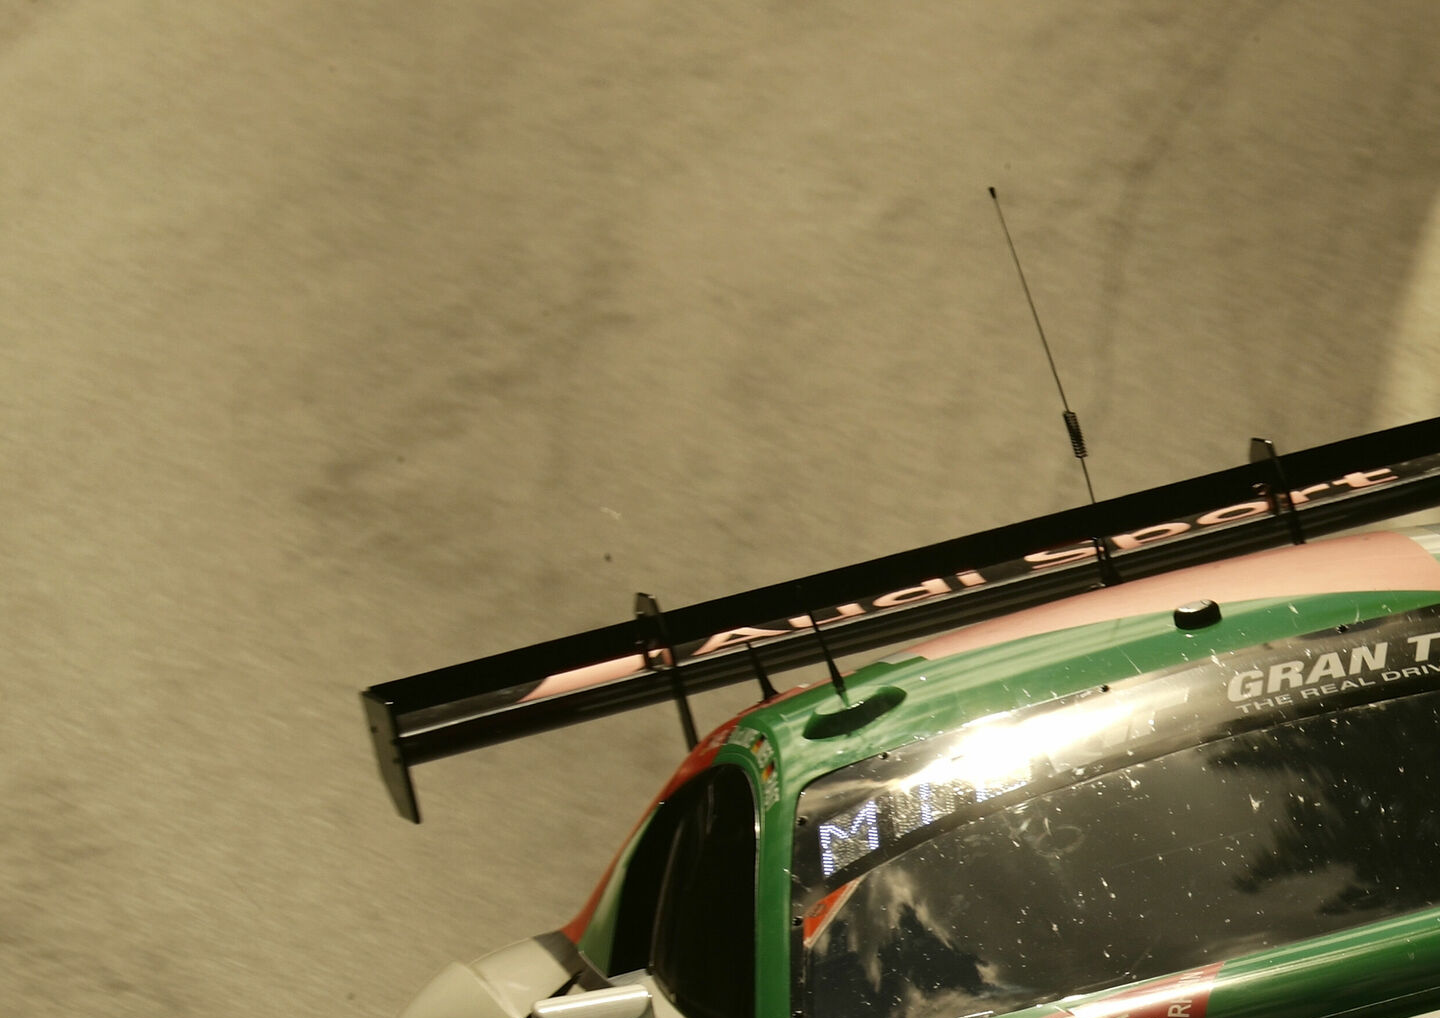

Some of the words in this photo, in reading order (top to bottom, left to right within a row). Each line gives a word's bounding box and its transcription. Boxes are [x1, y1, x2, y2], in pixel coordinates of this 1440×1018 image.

[691, 569, 988, 656] Audi
[1024, 467, 1400, 571] sport
[1226, 641, 1388, 703] GRAN
[1235, 694, 1293, 715] THE
[1301, 677, 1376, 701] REAL
